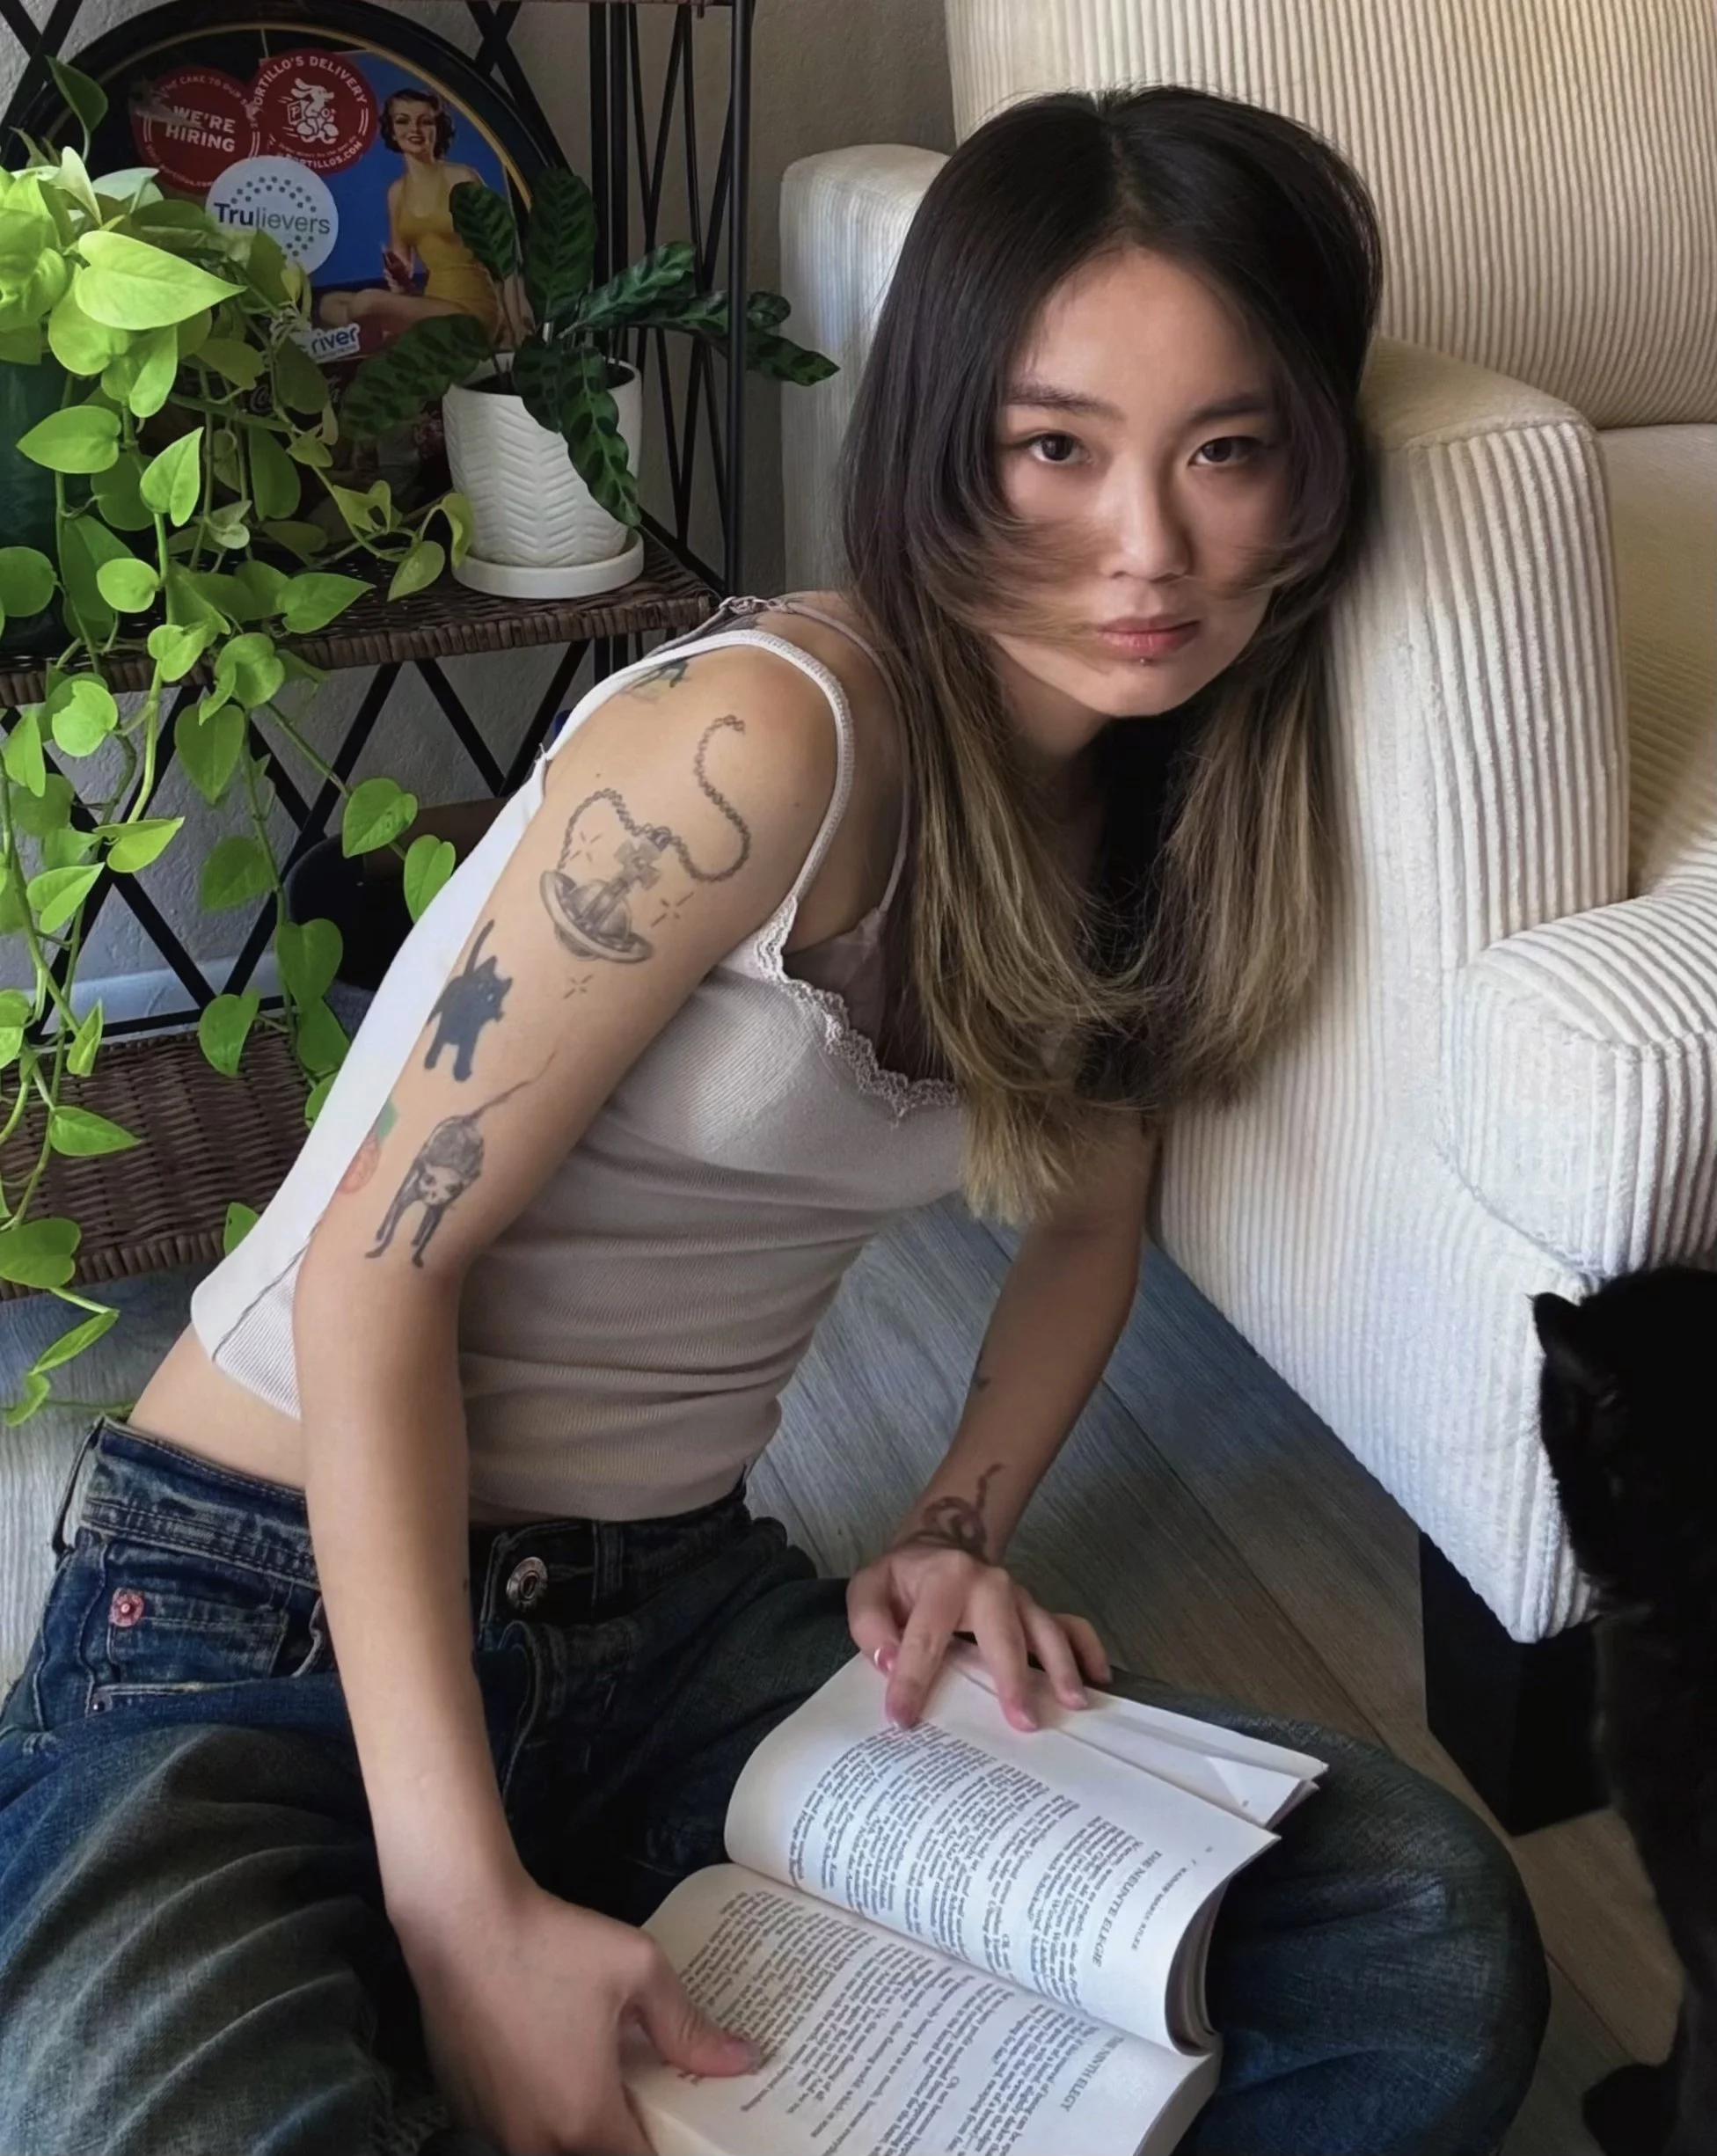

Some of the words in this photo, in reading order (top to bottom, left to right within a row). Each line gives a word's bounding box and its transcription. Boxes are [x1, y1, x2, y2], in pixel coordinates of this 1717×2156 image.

[309, 55, 369, 104] DELIVERY
[172, 106, 237, 134] WE'RE
[165, 123, 236, 153] HIRING
[213, 202, 332, 235] Trulievers
[1060, 2077, 1088, 2112] ELEGY
